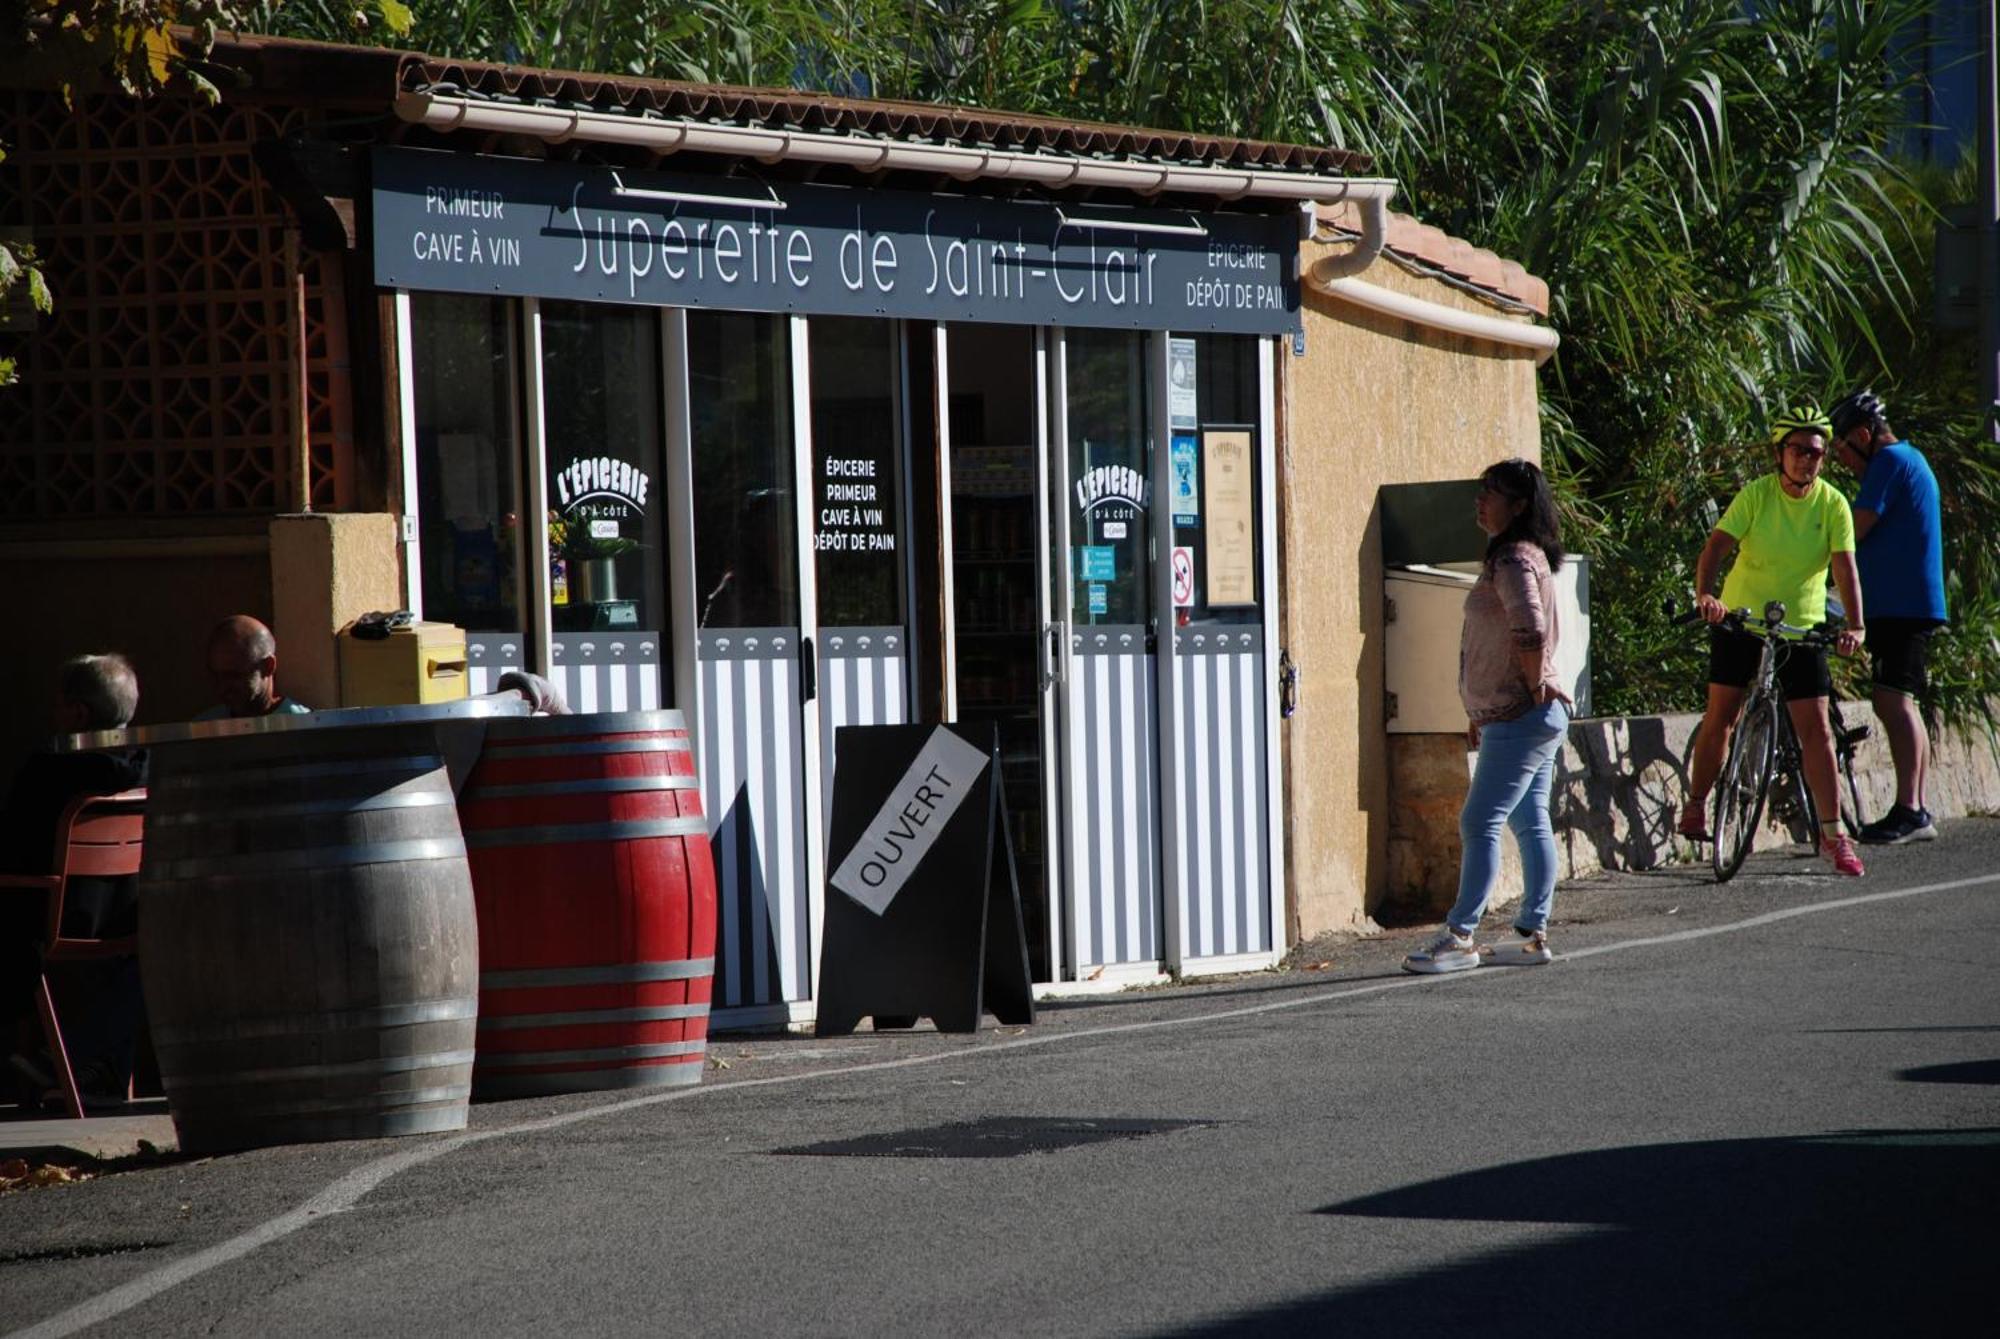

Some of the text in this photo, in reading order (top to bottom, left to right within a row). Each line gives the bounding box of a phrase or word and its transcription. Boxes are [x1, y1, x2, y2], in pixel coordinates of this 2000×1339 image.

[426, 185, 504, 219] PRIMEUR
[413, 228, 521, 267] CAVE À VIN
[573, 181, 1157, 306] Supérette de Saint-Clair
[1207, 237, 1267, 270] ÉPICERIE
[1186, 276, 1288, 310] DÉPÔT DE PAIN
[557, 456, 649, 506] L'ÉPICERIE
[826, 455, 876, 477] ÉPICERIE
[827, 484, 876, 501] PRIMEUR
[603, 504, 628, 517] CÔTÉ
[821, 505, 883, 526] CAVE À VIN
[1113, 507, 1134, 520] CÔTÉ
[851, 534, 866, 550] DE
[869, 534, 895, 551] PAIN
[860, 764, 952, 888] OUVERT
